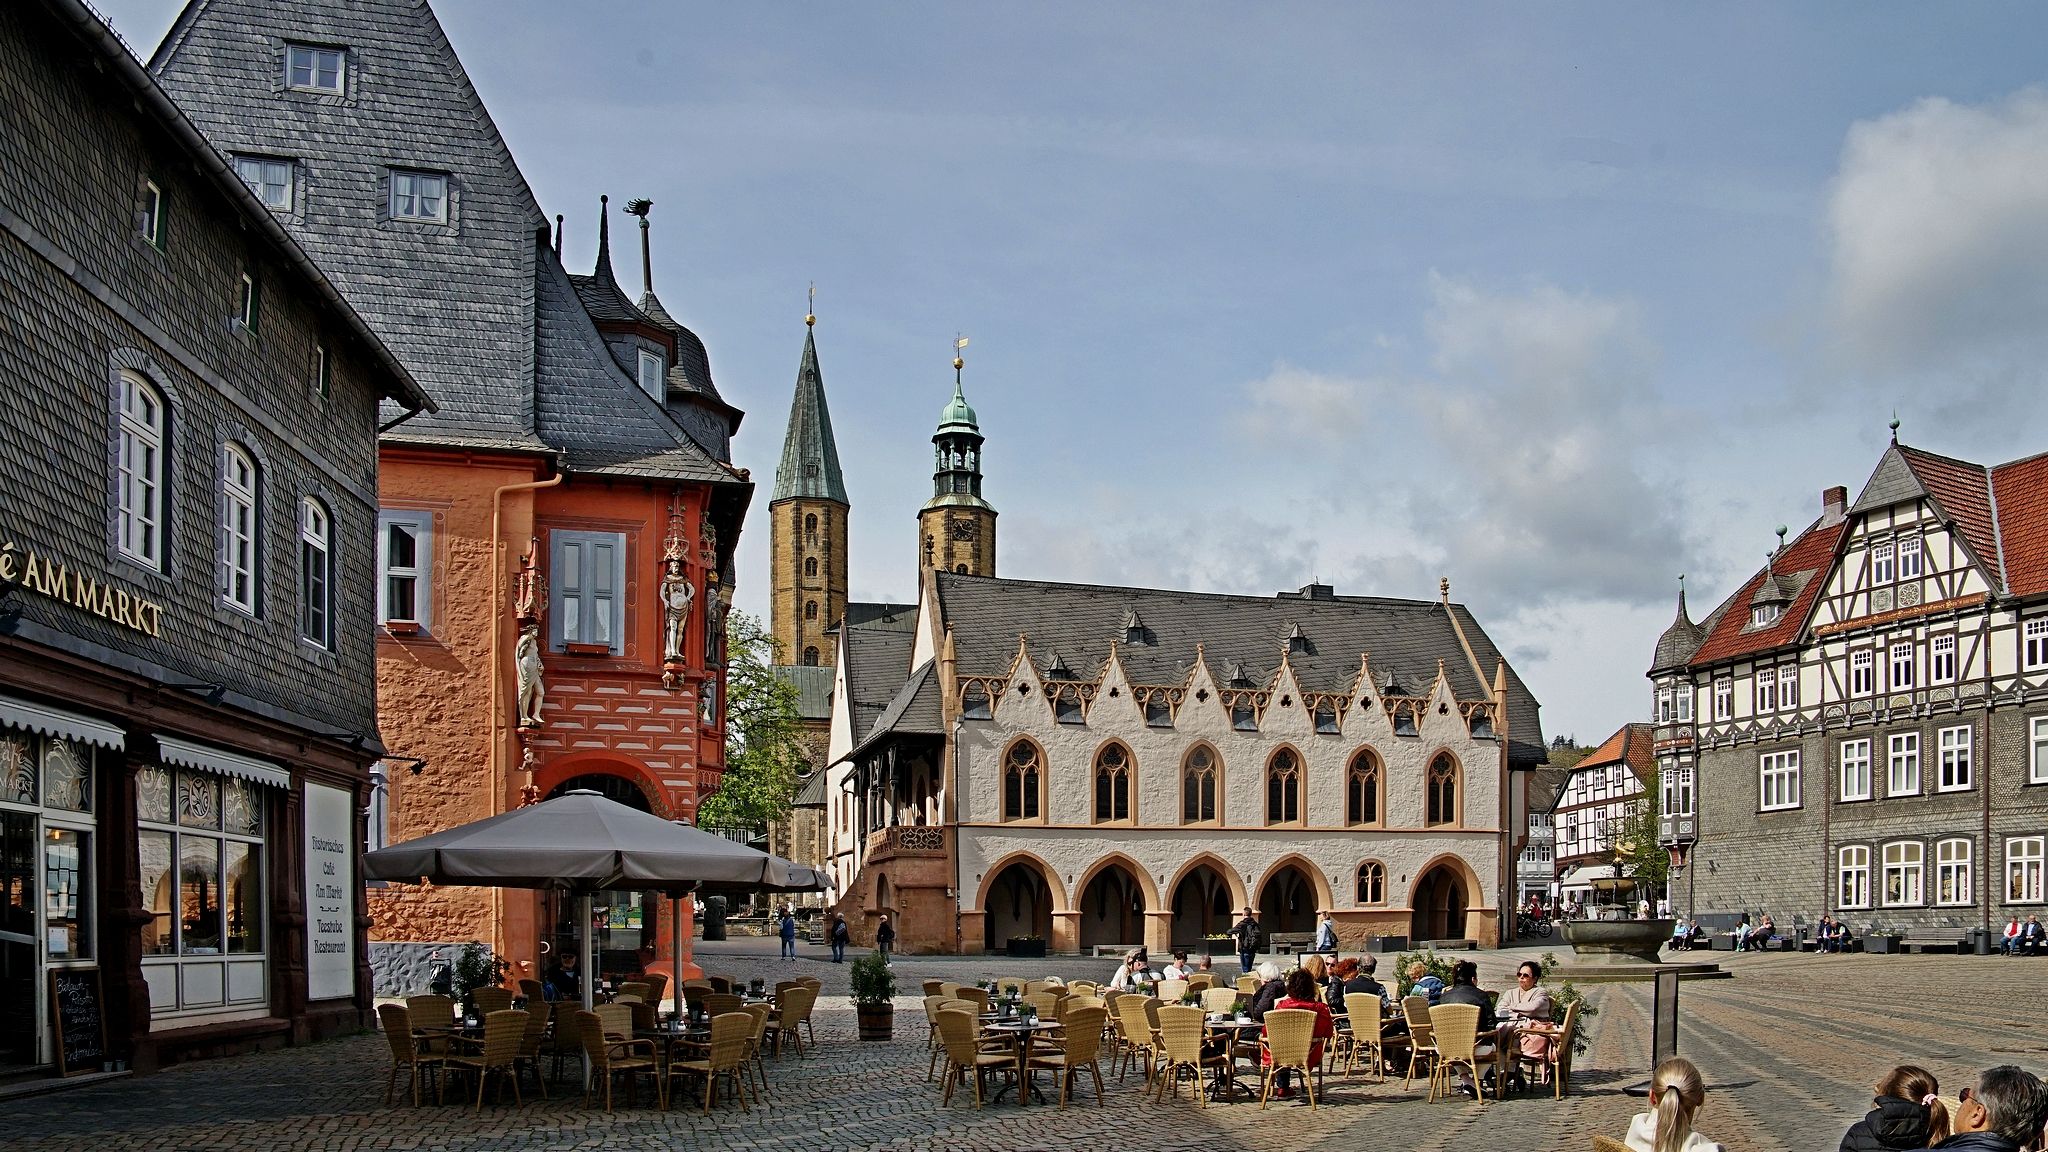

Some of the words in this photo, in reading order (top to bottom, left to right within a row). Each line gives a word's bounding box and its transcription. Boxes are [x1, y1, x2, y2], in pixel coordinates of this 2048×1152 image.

[21, 550, 71, 603] AM
[74, 570, 163, 637] MARKT
[322, 861, 335, 876] Café
[325, 885, 343, 900] Markt
[316, 918, 343, 933] Teestube
[314, 939, 346, 954] Restaurant
